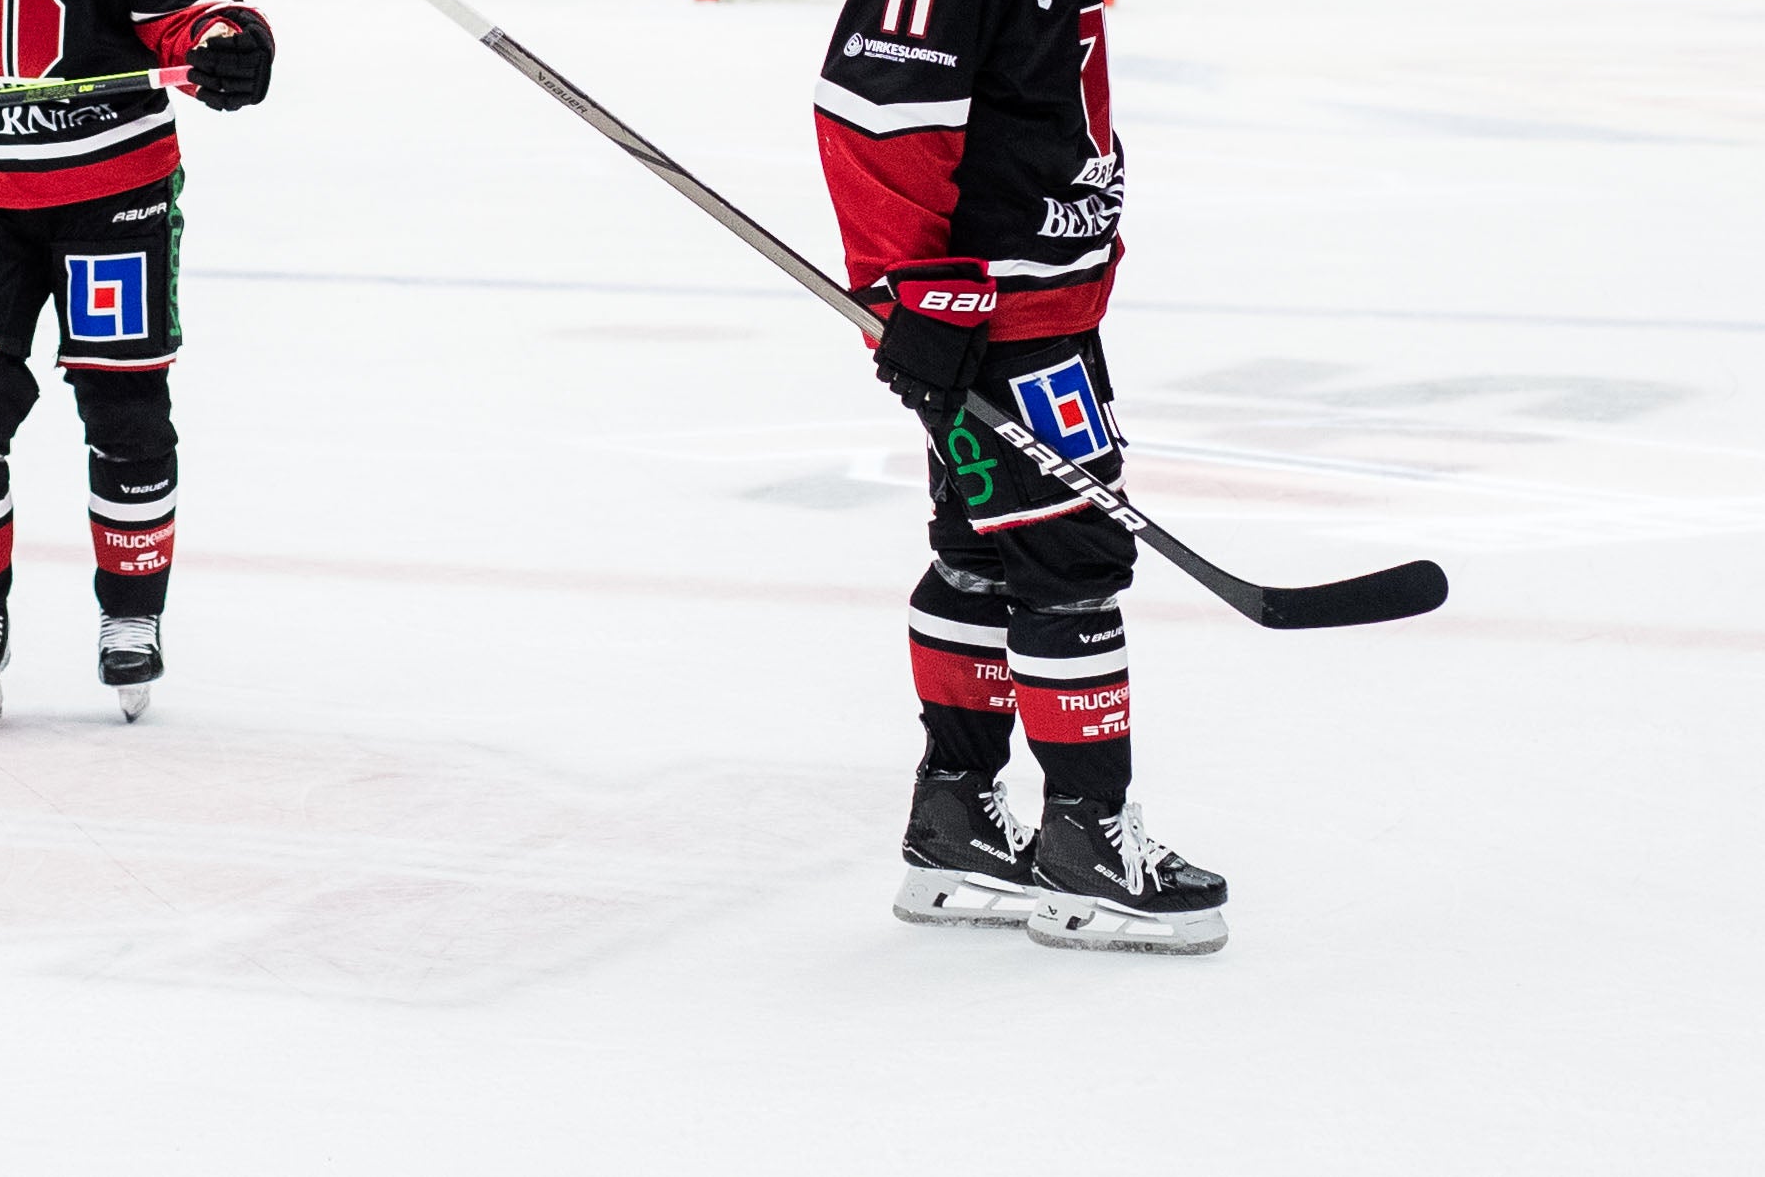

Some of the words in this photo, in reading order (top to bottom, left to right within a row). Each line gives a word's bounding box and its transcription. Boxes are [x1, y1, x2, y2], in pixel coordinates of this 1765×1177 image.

[864, 38, 958, 68] VIRKESLOGISTIK
[918, 290, 998, 313] BAU
[120, 555, 168, 571] STILL
[978, 662, 1014, 681] TRU
[1093, 863, 1131, 890] BAUE
